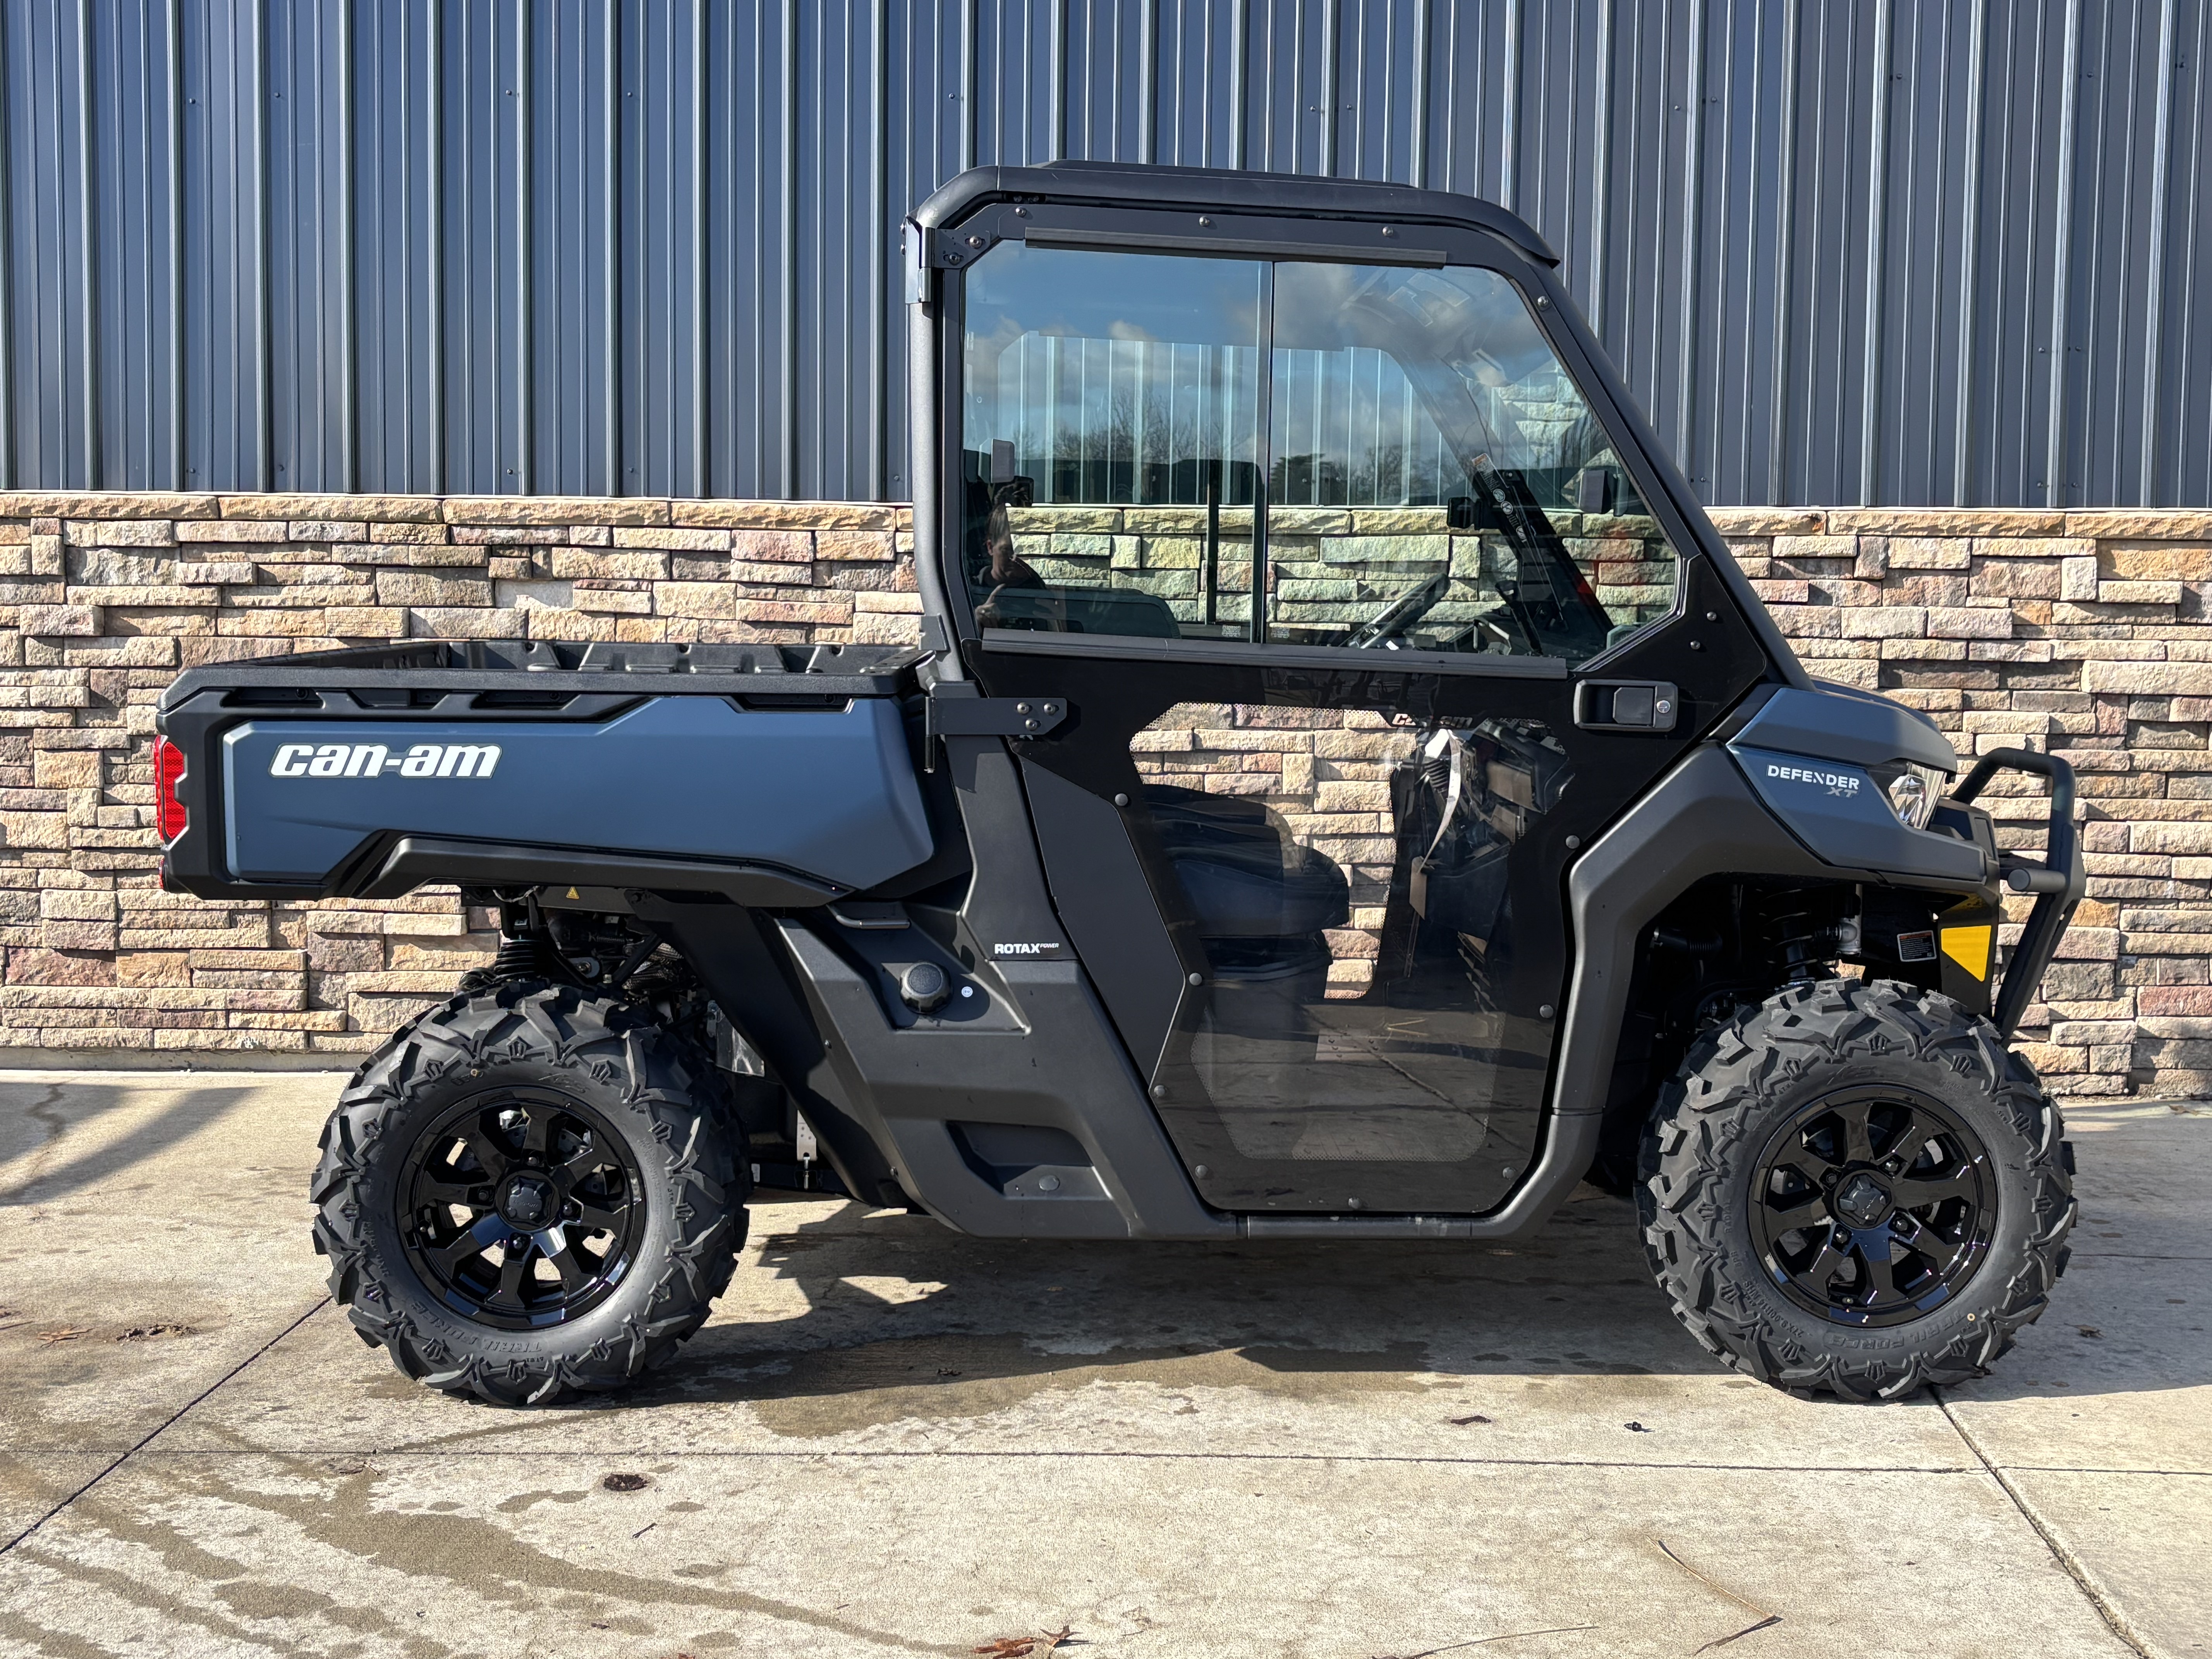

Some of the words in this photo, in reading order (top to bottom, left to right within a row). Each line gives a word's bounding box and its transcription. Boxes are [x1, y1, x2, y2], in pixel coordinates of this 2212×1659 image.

[1767, 764, 1859, 790] DEFENDER
[1826, 787, 1858, 797] XT
[994, 943, 1040, 954] ROTAX
[411, 1301, 478, 1345] FORCE
[1909, 1310, 1965, 1343] TRAIL
[484, 1341, 542, 1353] TRAIL
[1830, 1334, 1904, 1350] FORCE
